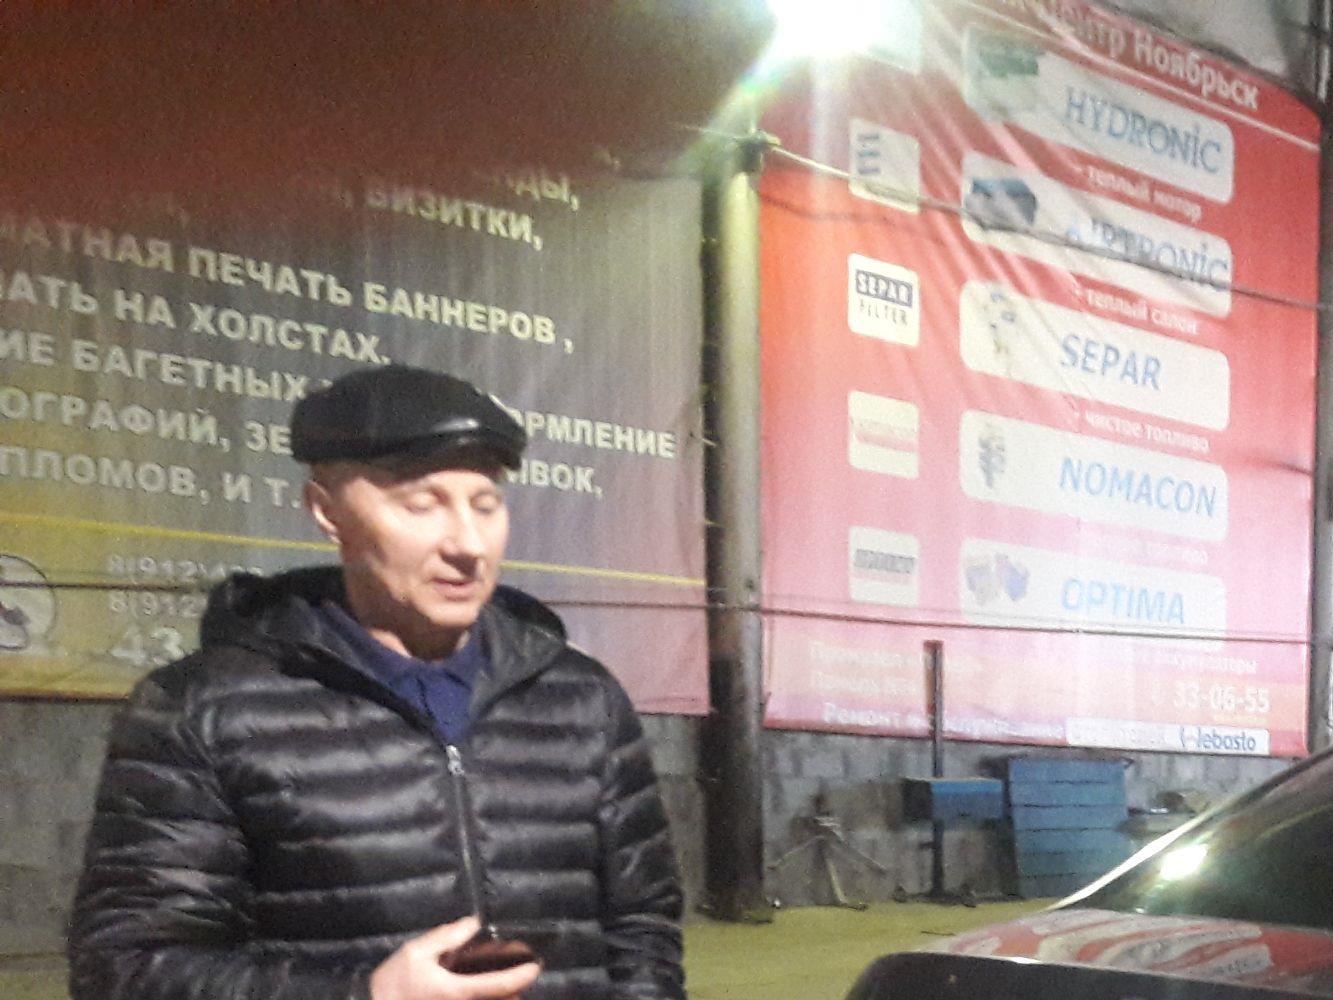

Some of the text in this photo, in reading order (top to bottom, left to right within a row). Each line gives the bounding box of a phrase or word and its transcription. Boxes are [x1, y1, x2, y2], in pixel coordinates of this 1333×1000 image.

[0, 271, 98, 315] АТЬ
[114, 290, 176, 329] НА
[188, 247, 353, 307] ПЕЧАТЬ
[857, 271, 912, 306] SEPAR
[71, 339, 308, 400] БАГЕТНЫХ
[1061, 334, 1162, 392] SEPAR
[244, 420, 291, 455] ЗЕ
[223, 472, 250, 503] И
[1060, 457, 1217, 518] NOMACON
[1062, 579, 1184, 625] OPTIMA
